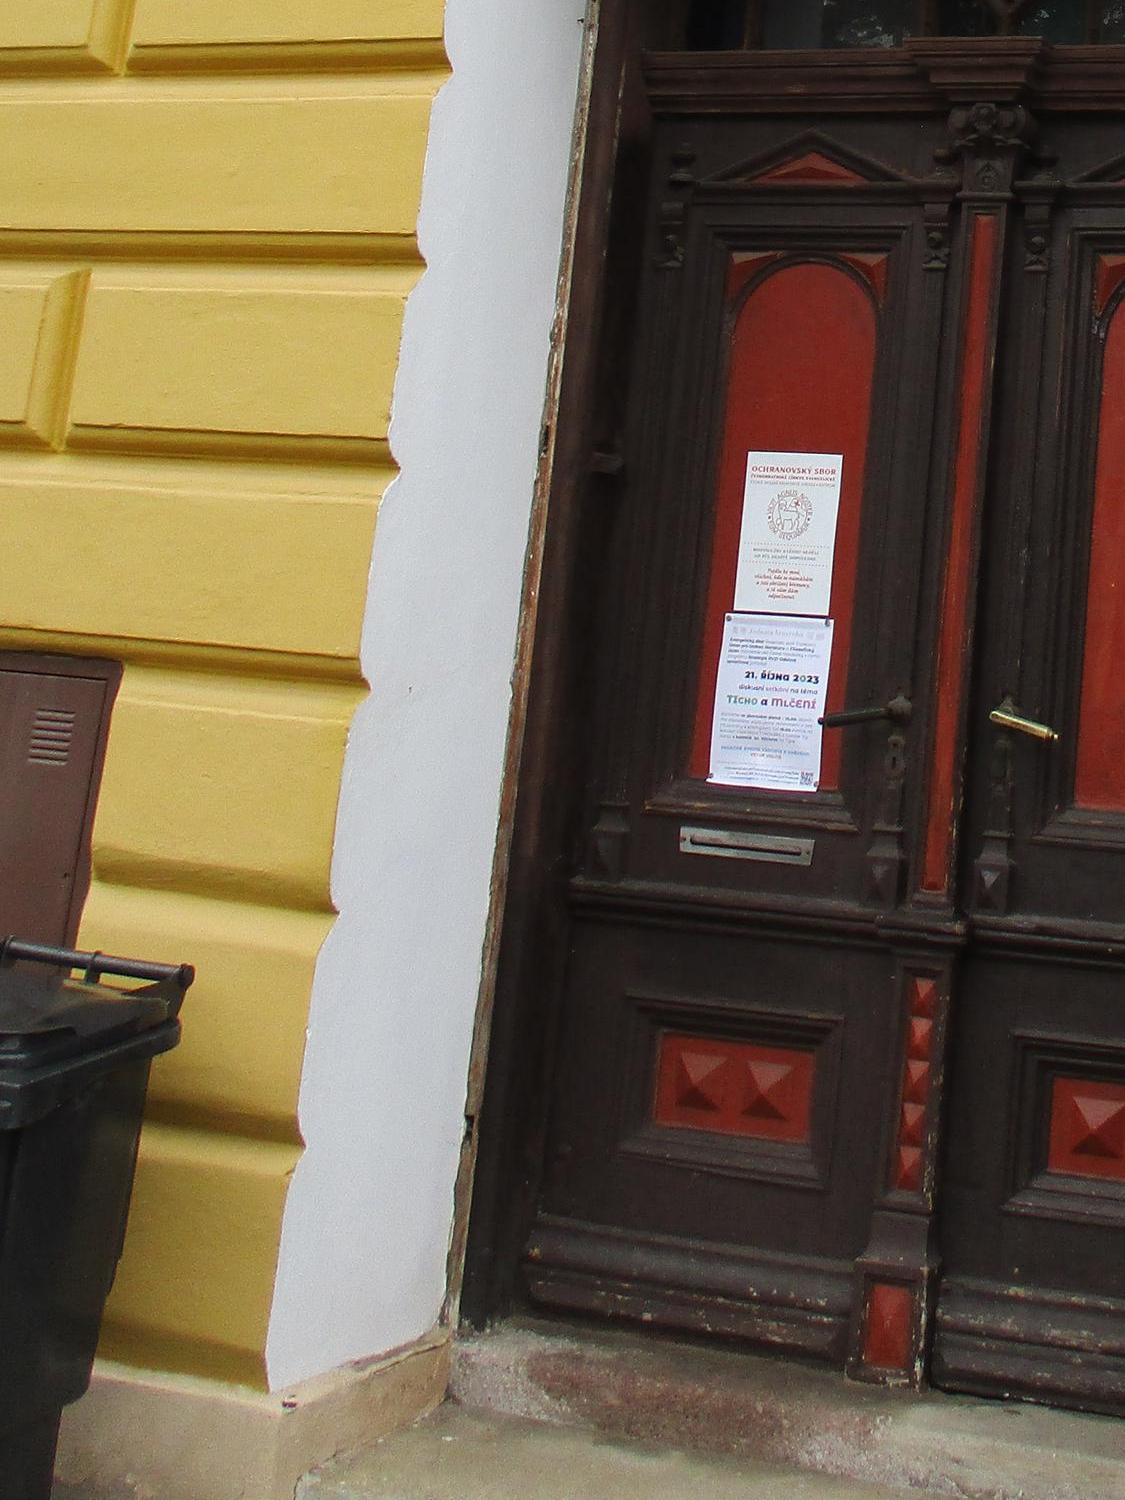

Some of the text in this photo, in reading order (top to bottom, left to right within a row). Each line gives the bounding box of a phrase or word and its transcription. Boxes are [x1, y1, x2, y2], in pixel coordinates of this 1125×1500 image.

[814, 468, 837, 476] SBOR
[744, 671, 758, 680] 21.
[793, 674, 820, 685] 2023
[760, 698, 769, 707] a
